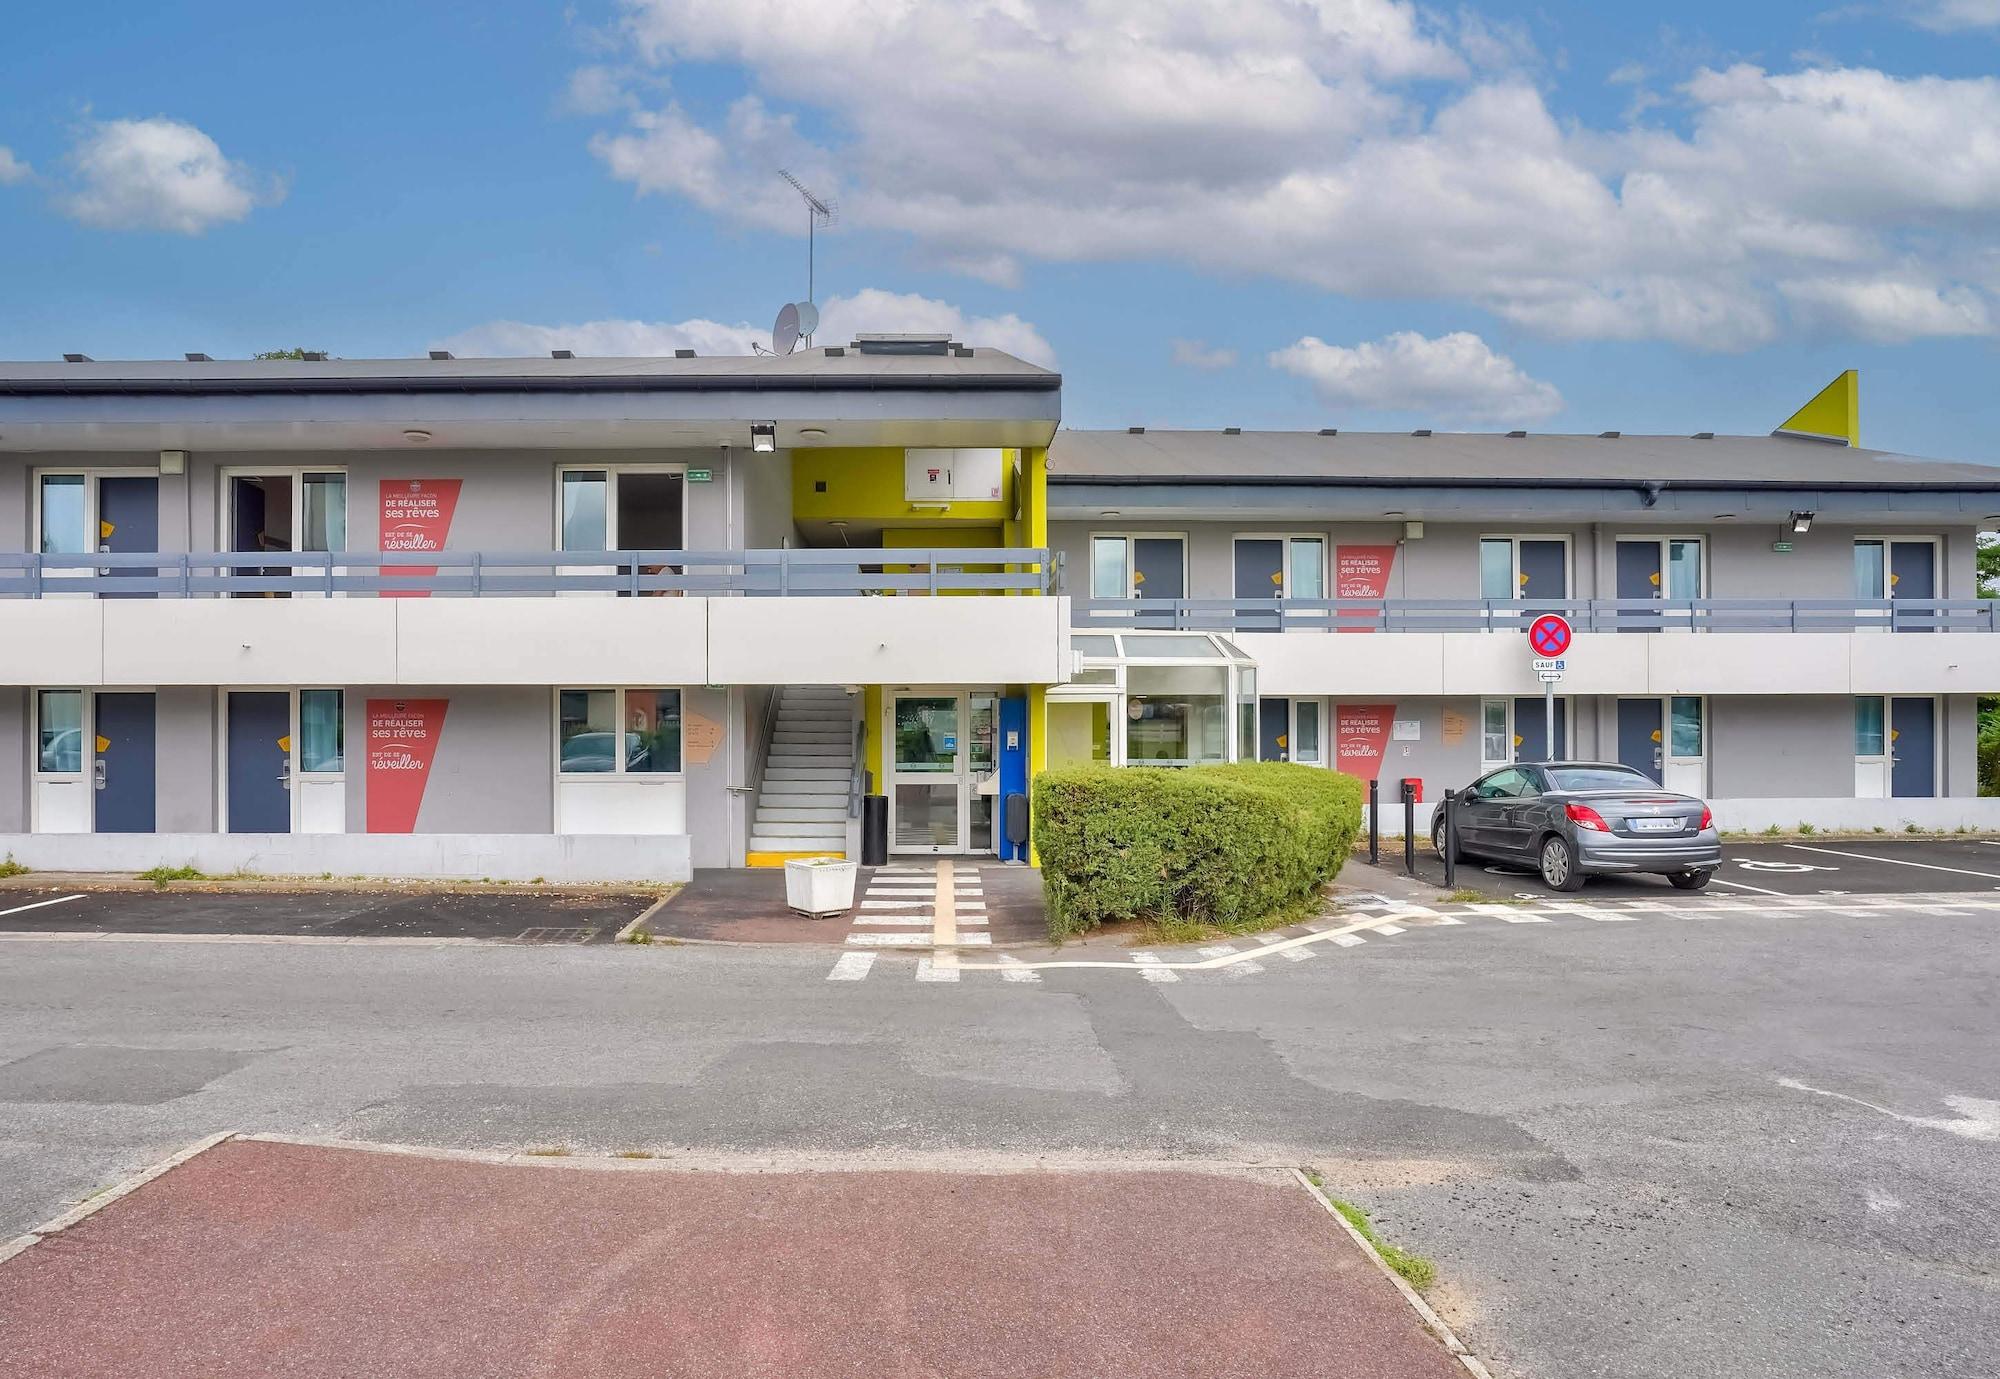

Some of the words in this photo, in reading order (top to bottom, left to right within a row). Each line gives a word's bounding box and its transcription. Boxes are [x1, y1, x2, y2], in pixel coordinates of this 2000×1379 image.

[398, 497, 437, 507] RÉALISER
[385, 509, 404, 518] ses
[406, 507, 440, 518] rêves
[384, 533, 437, 549] réveiller
[1356, 565, 1381, 574] rêves
[1340, 585, 1379, 597] réveiller
[385, 717, 424, 727] RÉALISER
[372, 729, 391, 738] ses
[393, 727, 427, 738] rêves
[1356, 725, 1381, 734] rêves
[1340, 745, 1379, 757] réveiller
[371, 753, 424, 769] réveiller
